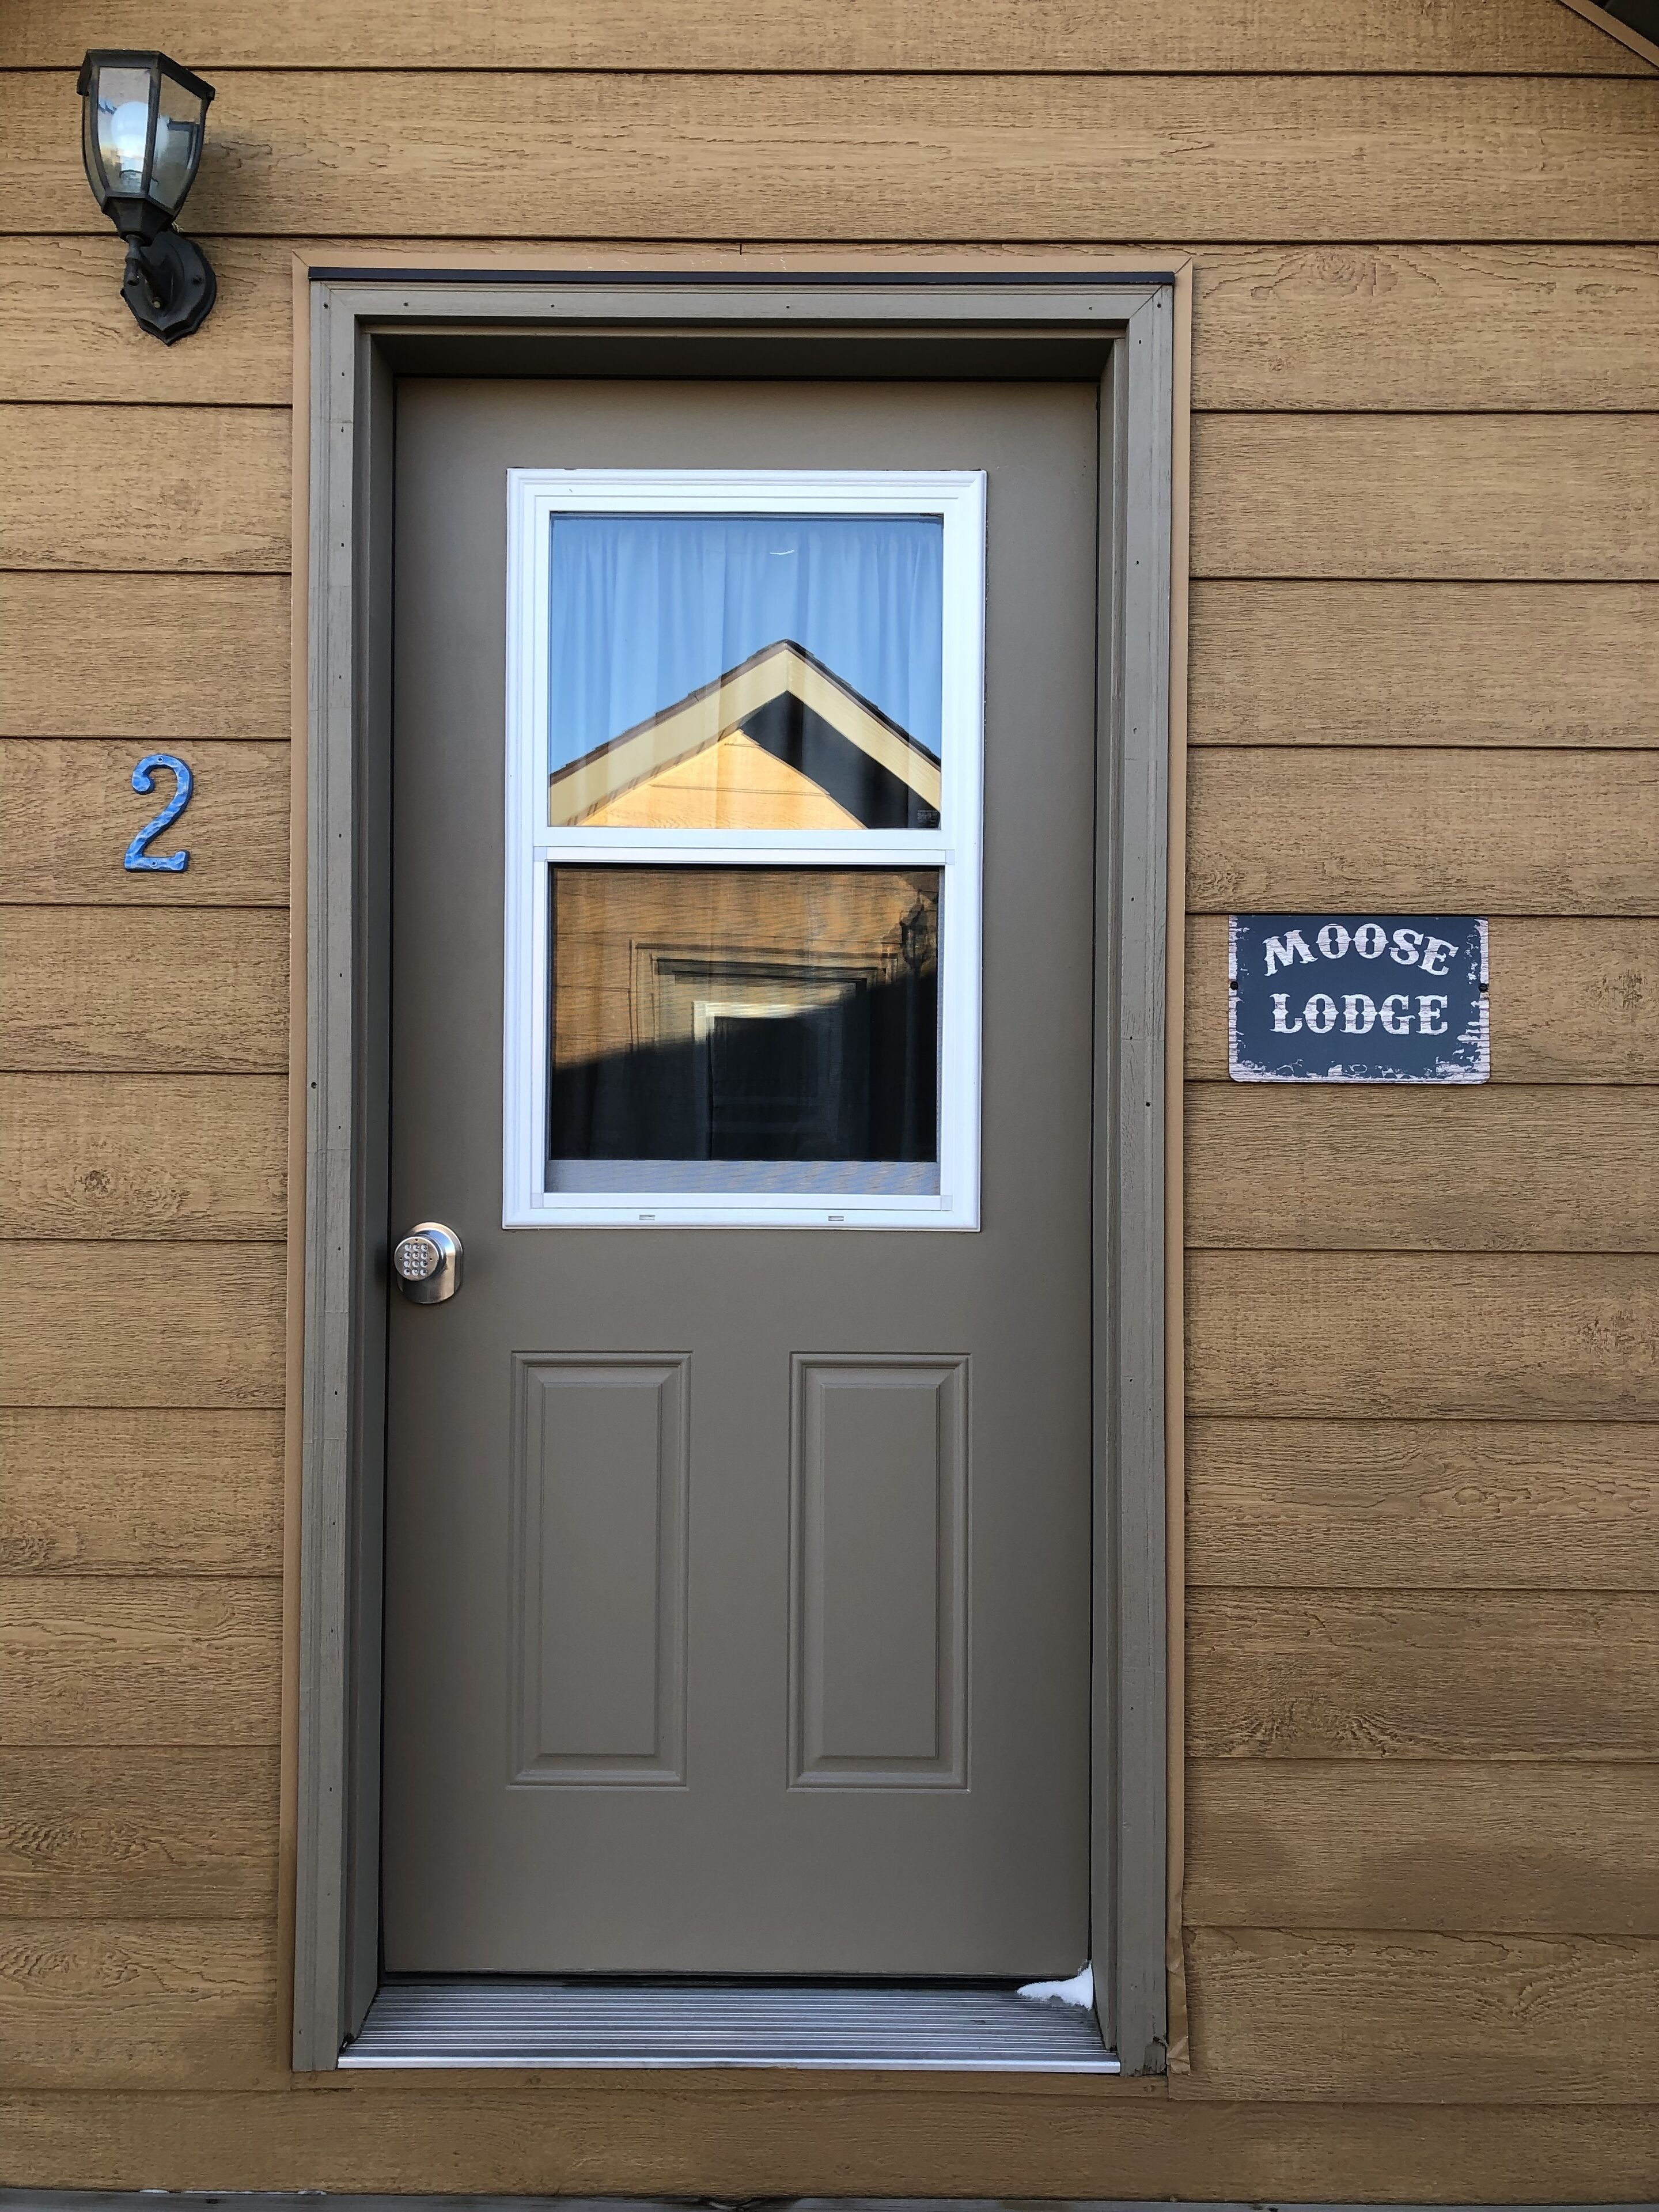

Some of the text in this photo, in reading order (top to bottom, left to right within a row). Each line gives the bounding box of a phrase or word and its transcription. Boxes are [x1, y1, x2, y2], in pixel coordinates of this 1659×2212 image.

[124, 753, 192, 872] 2
[1262, 923, 1459, 976] MOOSE
[1268, 993, 1449, 1036] LODGE
